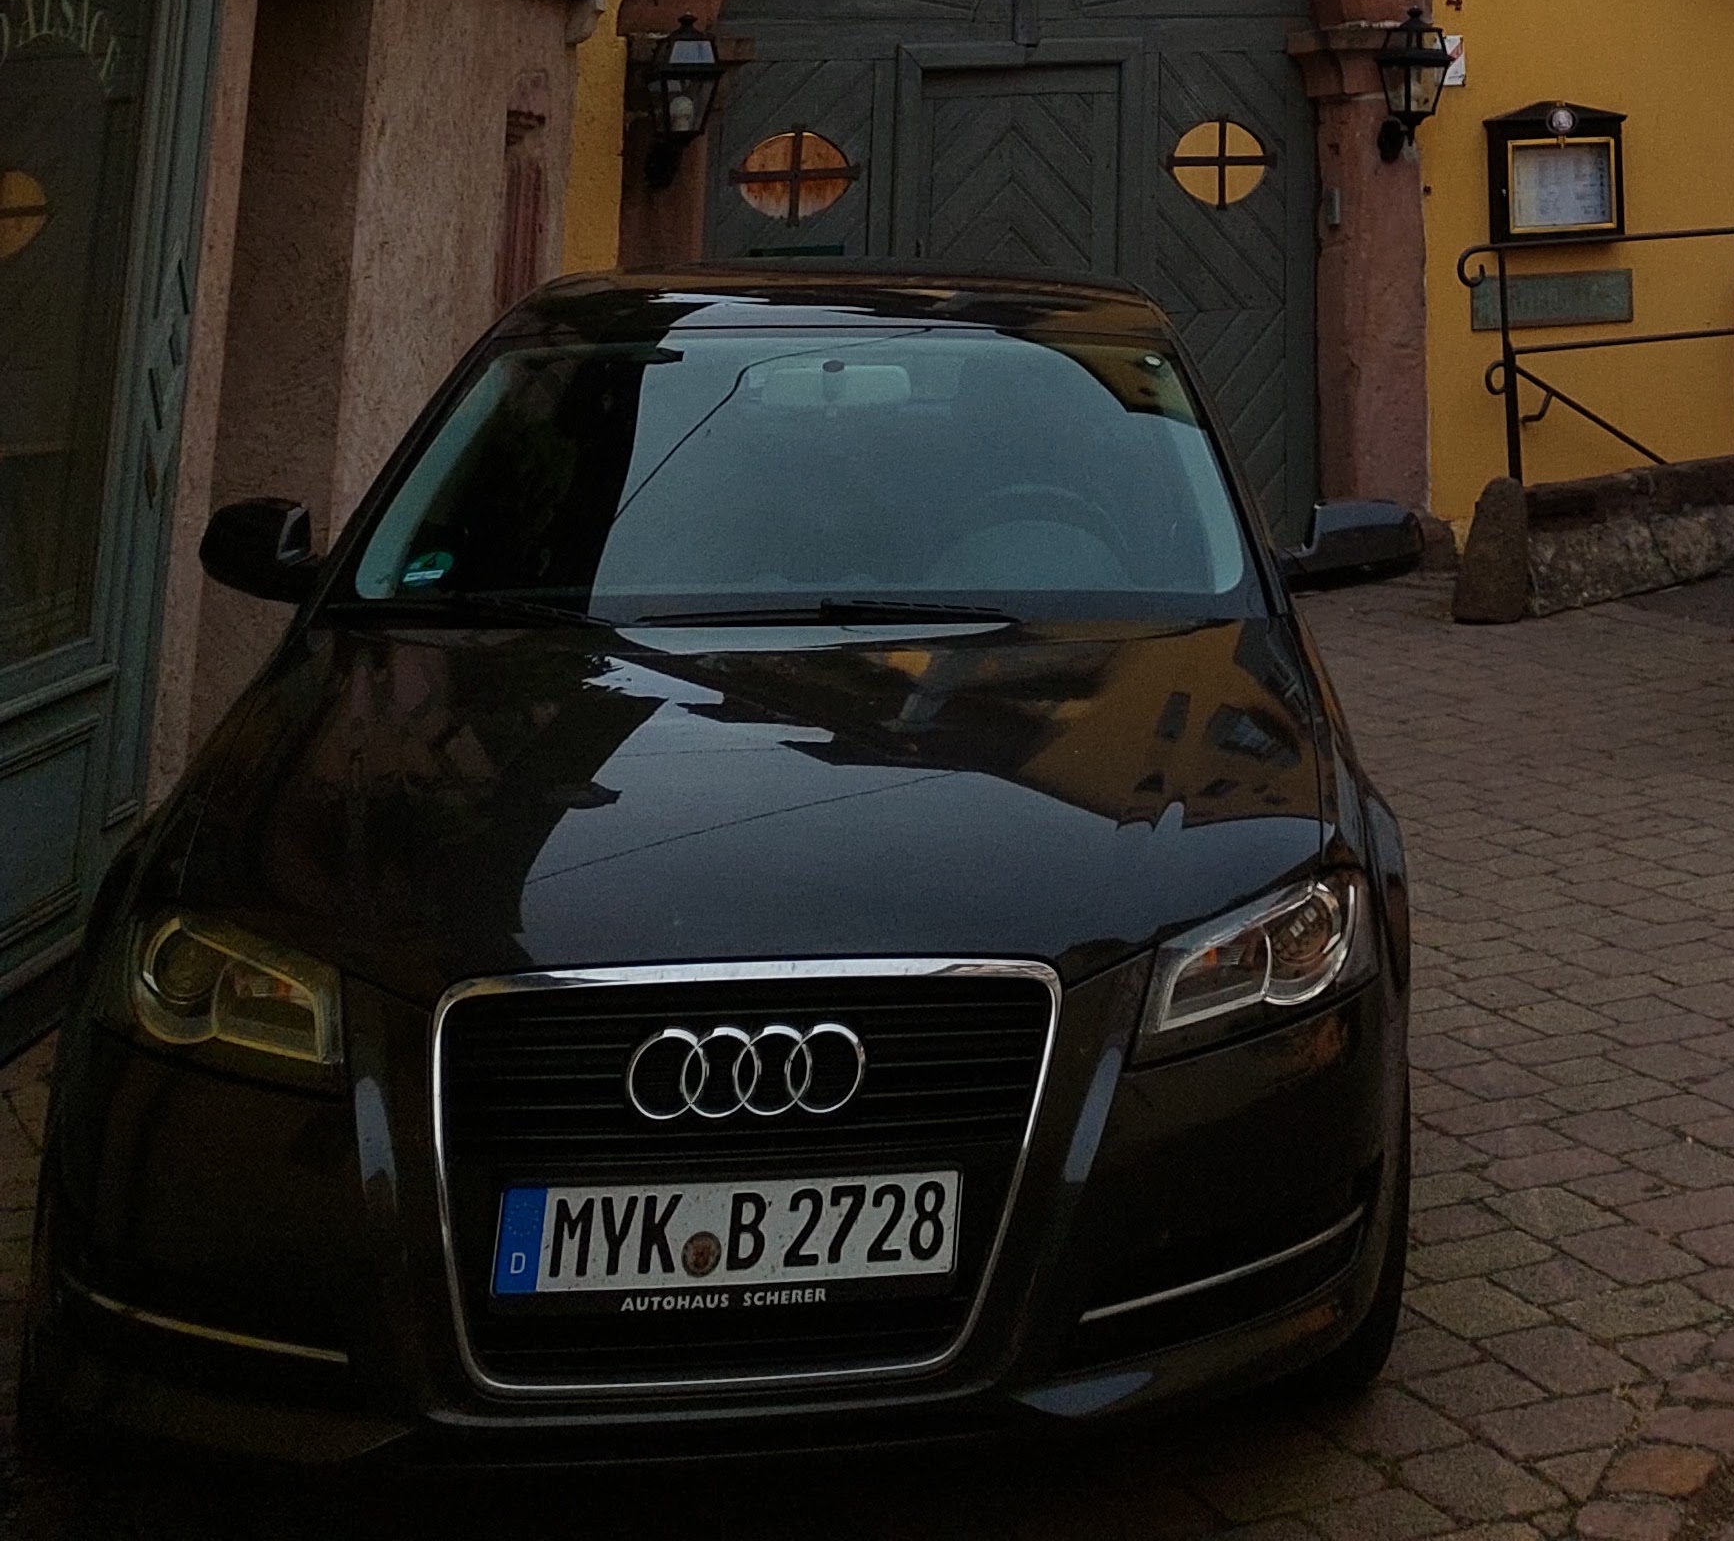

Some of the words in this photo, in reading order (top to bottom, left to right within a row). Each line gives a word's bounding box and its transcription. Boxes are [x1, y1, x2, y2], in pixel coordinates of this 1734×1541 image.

[510, 1252, 526, 1275] D
[549, 1193, 683, 1279] MYK
[726, 1191, 768, 1272] B
[784, 1180, 946, 1268] 2728
[620, 1293, 730, 1313] AUTOHAUS
[742, 1288, 827, 1307] SCHERER
